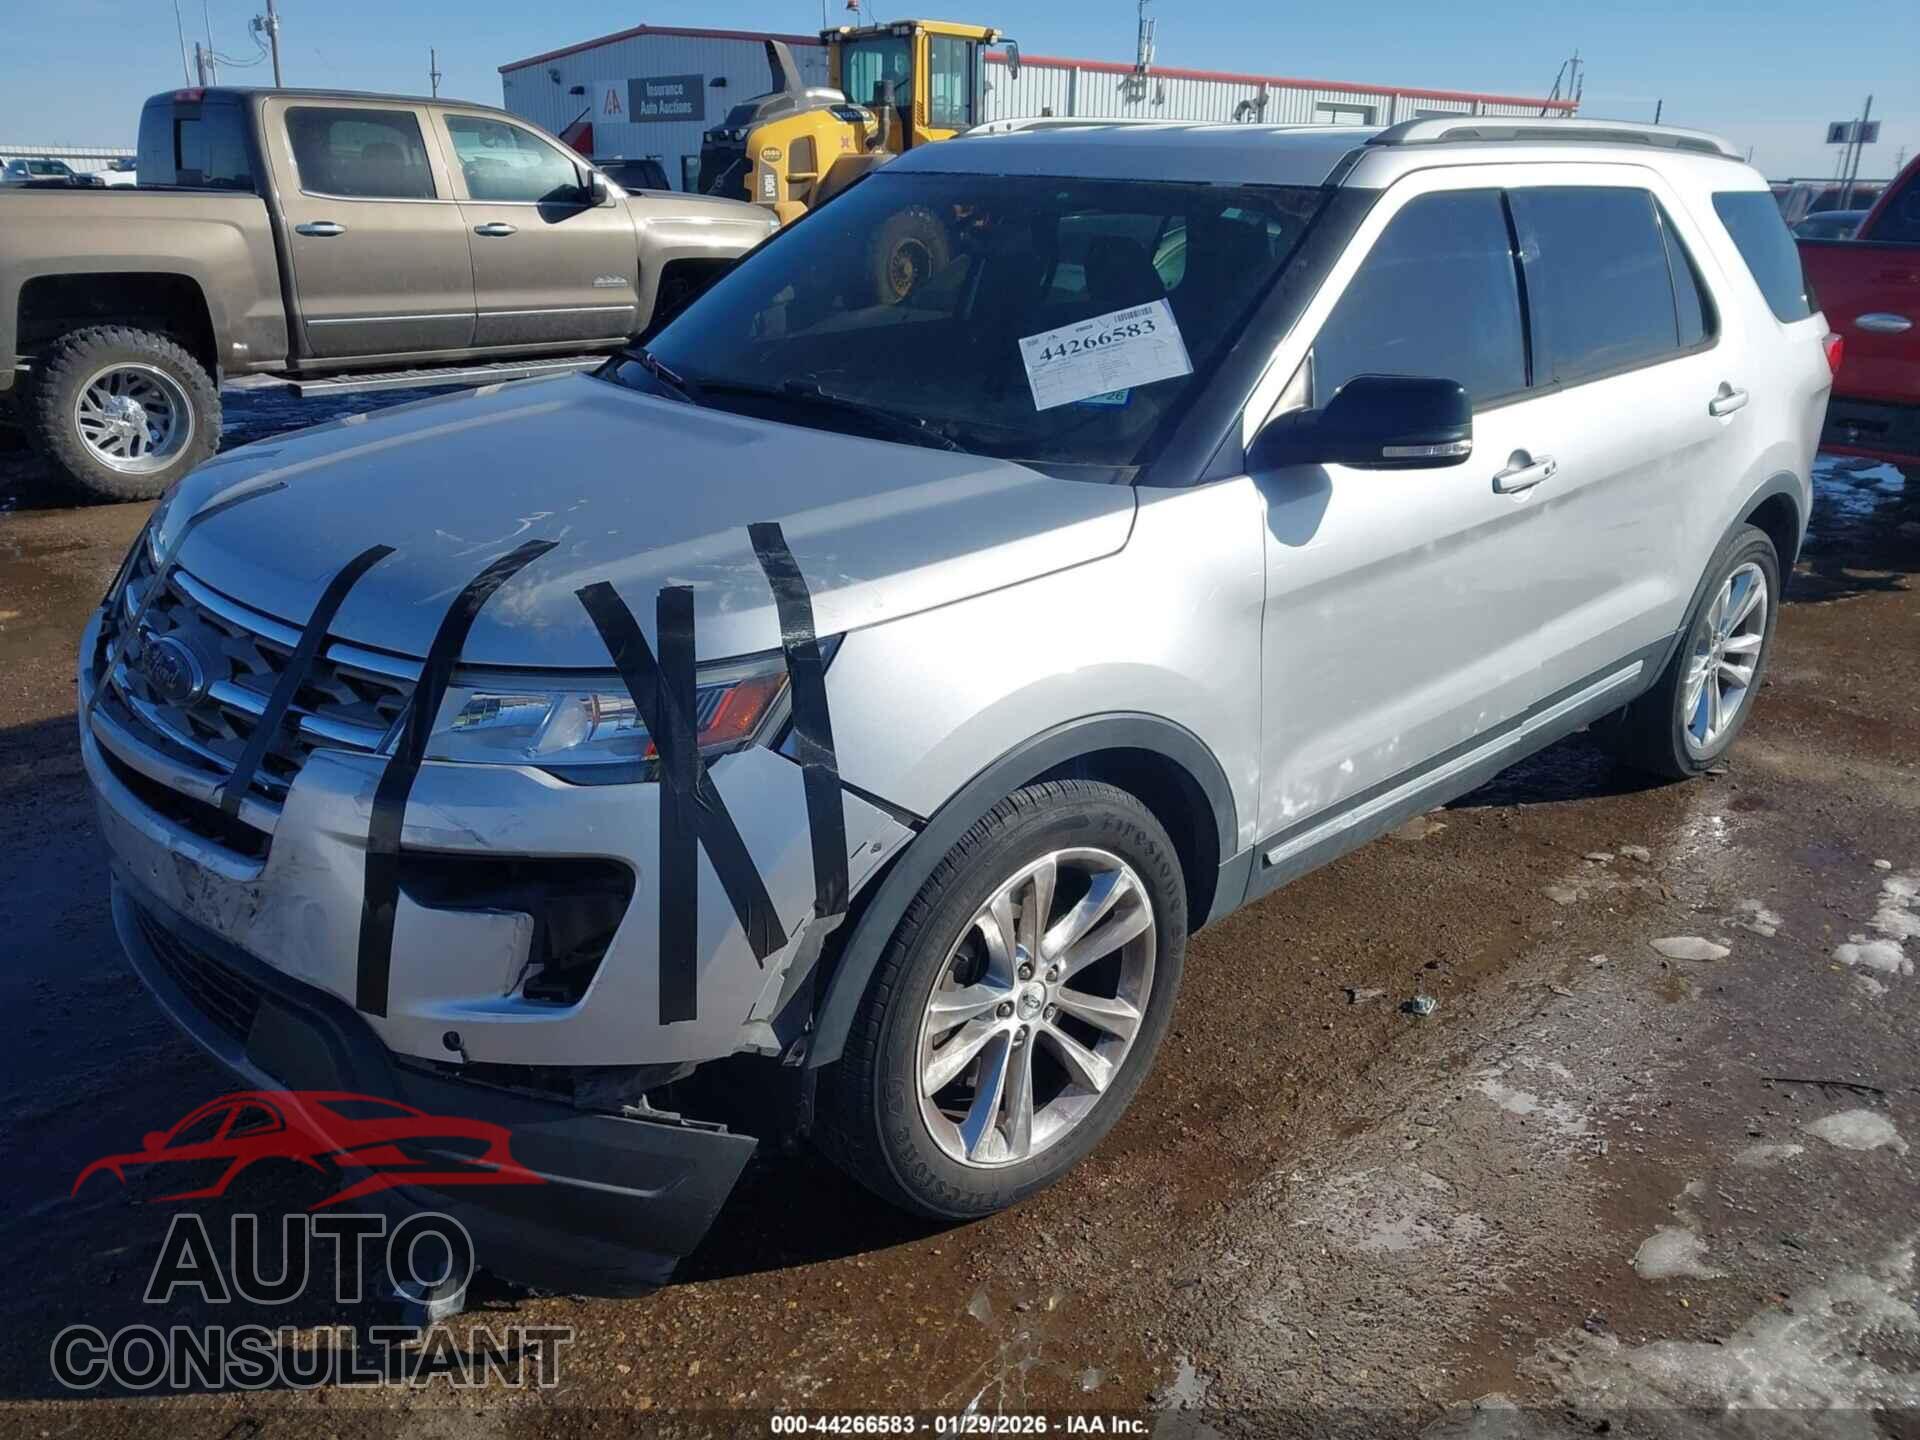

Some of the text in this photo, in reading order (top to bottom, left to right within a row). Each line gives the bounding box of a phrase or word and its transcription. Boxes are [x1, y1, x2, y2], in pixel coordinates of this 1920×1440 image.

[646, 82, 684, 97] Insurance
[640, 99, 692, 115] Auto Auctions
[1039, 319, 1156, 361] 44266583
